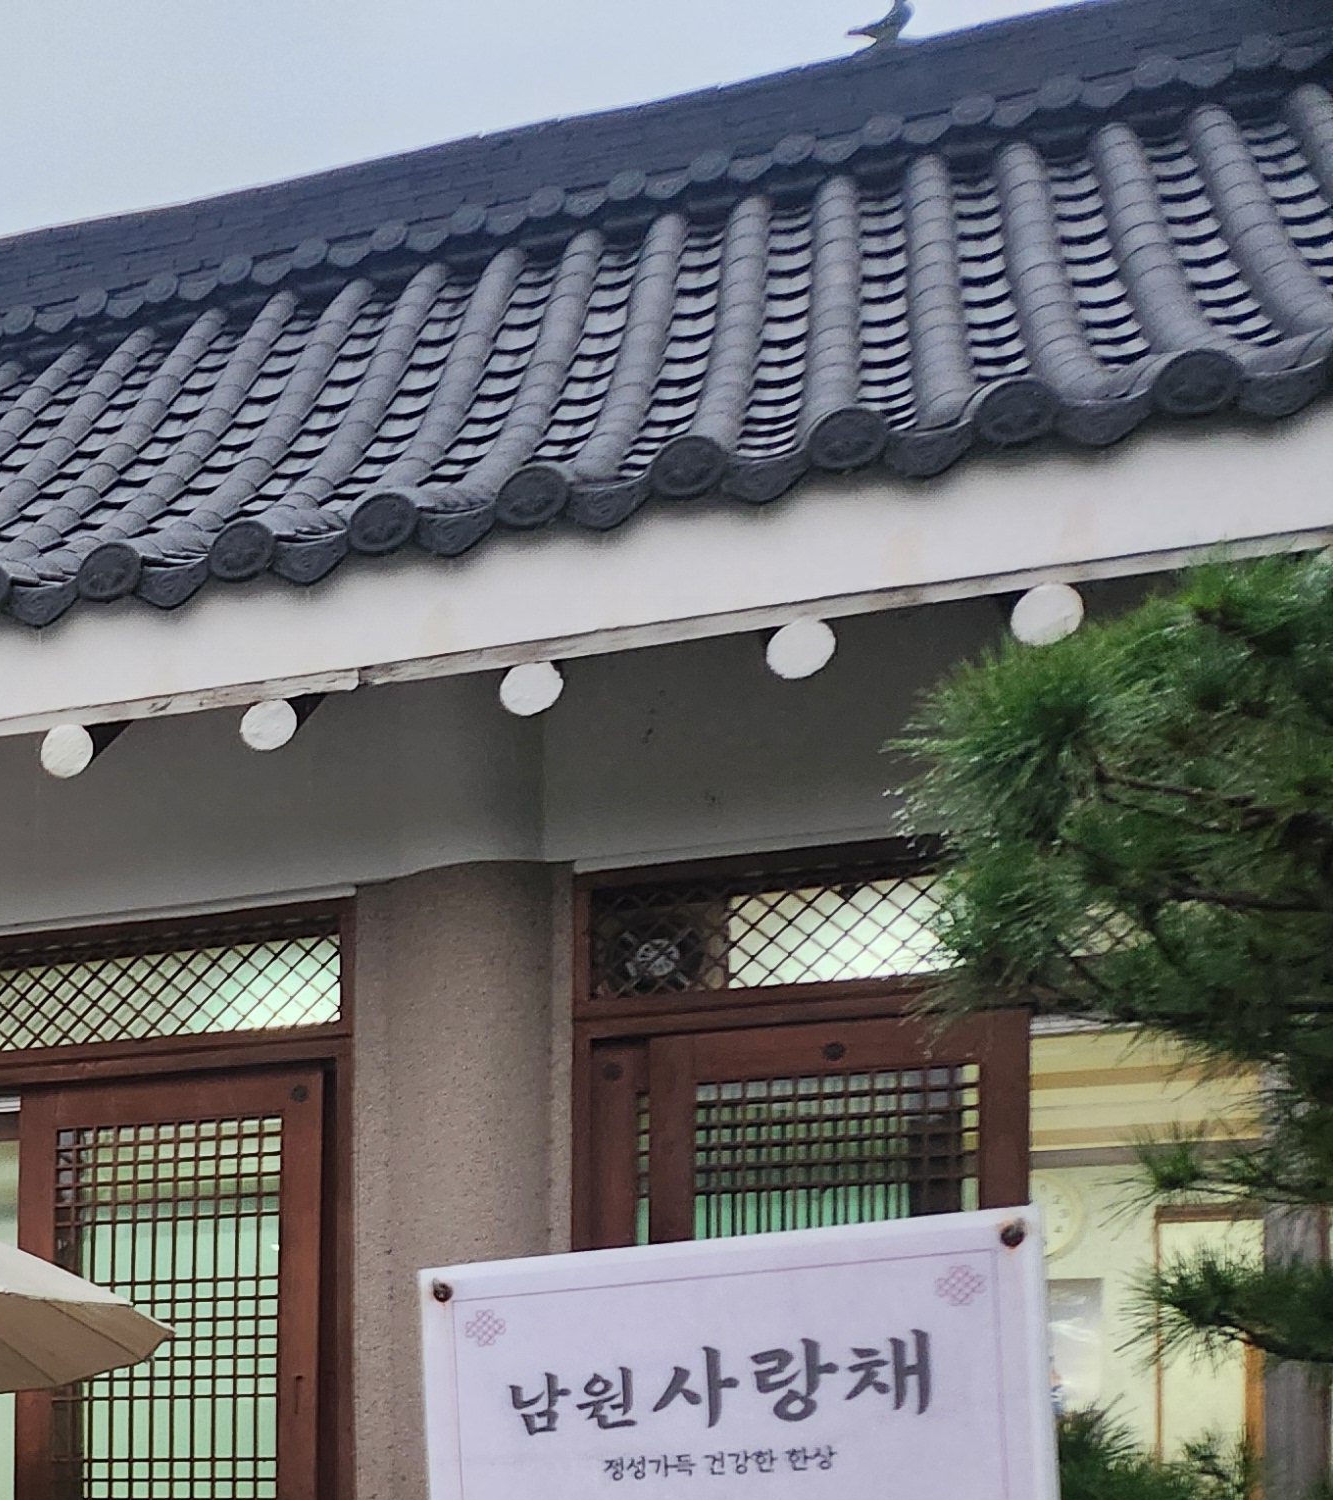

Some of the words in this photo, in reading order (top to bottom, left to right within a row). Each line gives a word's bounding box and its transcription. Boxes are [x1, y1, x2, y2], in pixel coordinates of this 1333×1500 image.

[604, 1453, 696, 1482] 정성가득
[704, 1448, 777, 1476] 건강한
[785, 1445, 837, 1471] 한상
